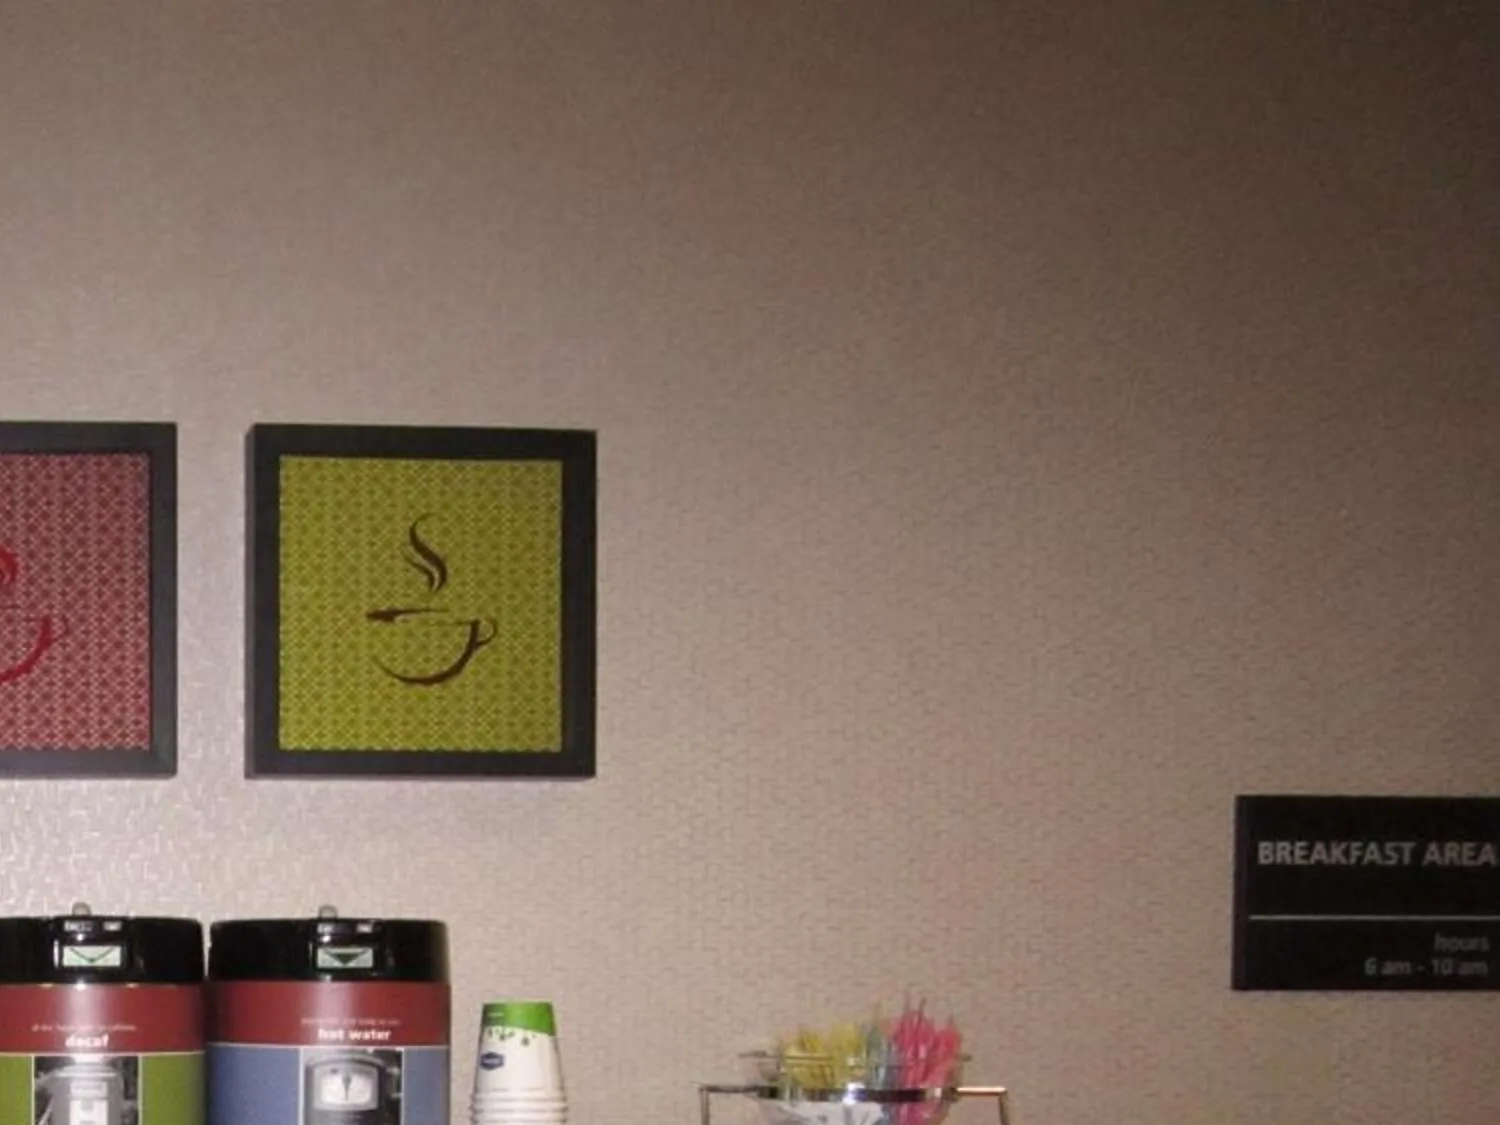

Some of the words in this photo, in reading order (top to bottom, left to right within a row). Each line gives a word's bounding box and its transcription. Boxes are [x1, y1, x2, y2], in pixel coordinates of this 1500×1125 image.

[1257, 841, 1416, 866] BREAKFAST
[1422, 841, 1499, 867] AREA
[1433, 932, 1490, 952] hours
[1364, 956, 1378, 976] 6
[1380, 959, 1412, 976] am
[1431, 957, 1455, 976] 10
[1457, 959, 1488, 976] am
[348, 1029, 392, 1041] water
